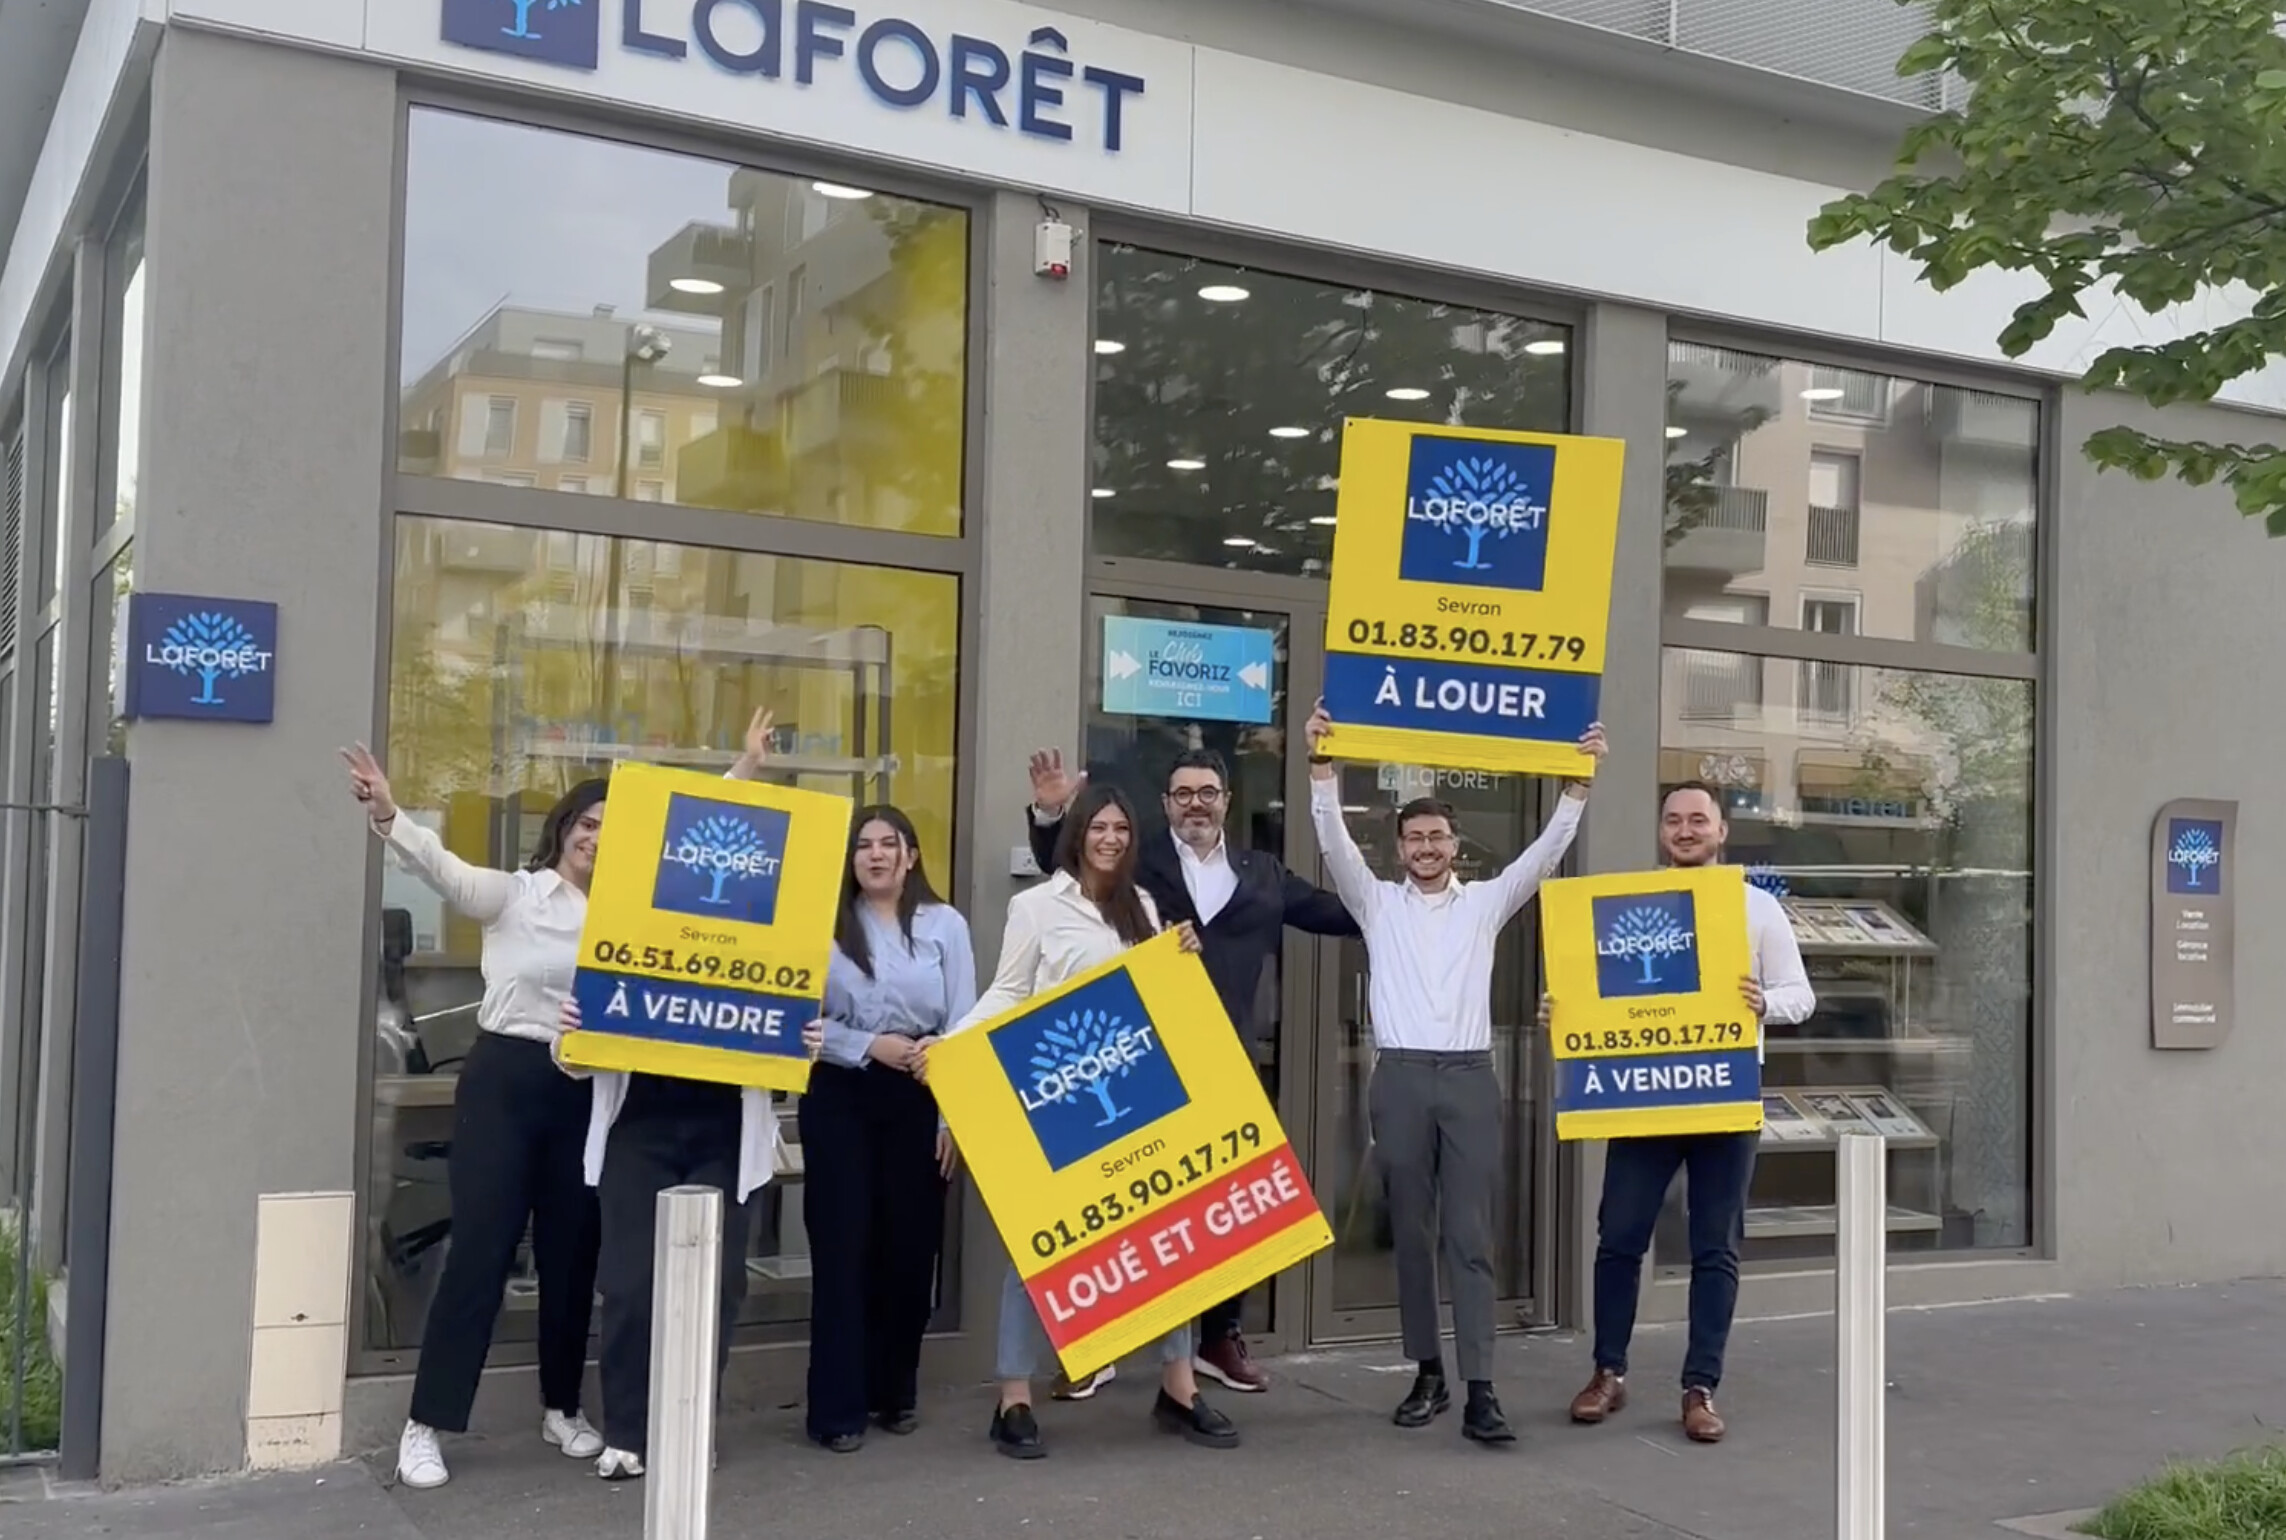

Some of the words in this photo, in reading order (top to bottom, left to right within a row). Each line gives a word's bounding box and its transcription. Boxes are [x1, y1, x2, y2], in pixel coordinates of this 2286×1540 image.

[1436, 597, 1502, 616] Sevran
[1148, 650, 1160, 659] LE
[1163, 641, 1203, 663] Club
[1347, 618, 1586, 662] 01.83.90.17.79
[1177, 691, 1202, 708] ICI
[1374, 664, 1401, 707] À
[1414, 676, 1547, 719] LOUER
[679, 926, 738, 947] Sevran
[594, 940, 811, 990] 06.51.69.80.02
[603, 981, 630, 1017] À
[642, 990, 786, 1037] VENDRE
[1627, 1005, 1676, 1019] Sevran
[1565, 1022, 1742, 1051] 01.83.90.17.79
[1584, 1064, 1604, 1094] À
[1611, 1063, 1732, 1093] VENDRE
[1100, 1136, 1166, 1178] Sevran
[1031, 1121, 1263, 1258] 01.83.90.17.79
[1044, 1239, 1149, 1323] LOUÉ
[1151, 1218, 1197, 1267] ET
[1205, 1159, 1301, 1237] GÉRÉ
